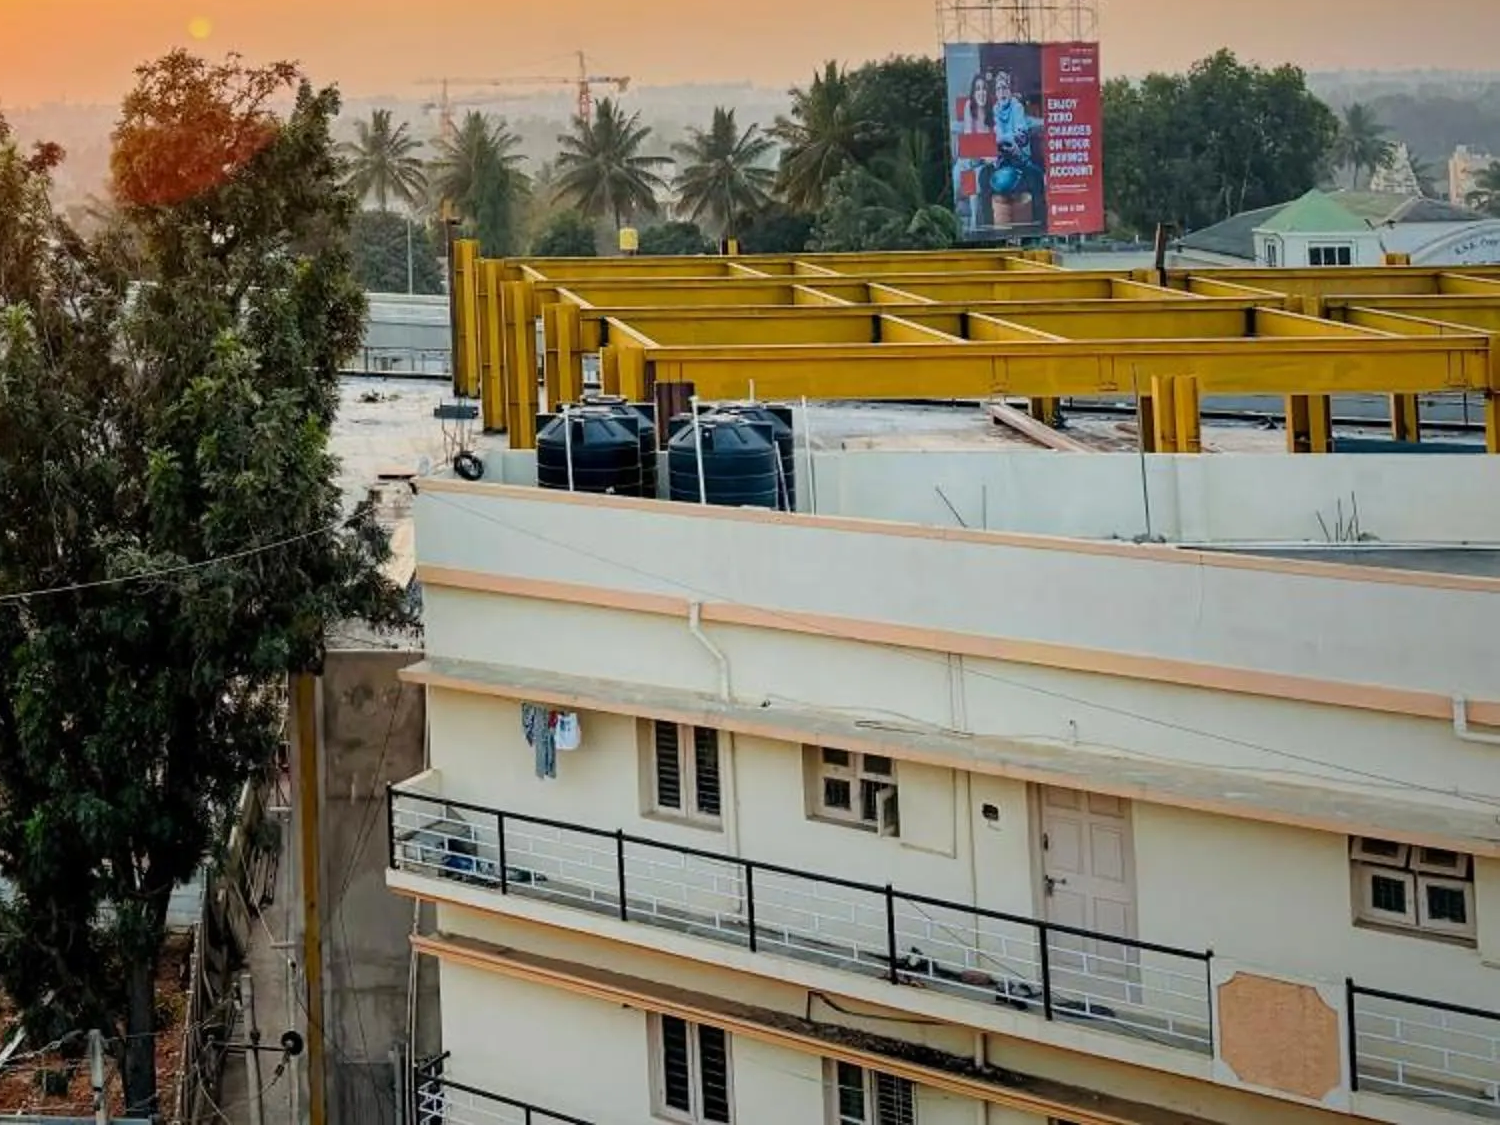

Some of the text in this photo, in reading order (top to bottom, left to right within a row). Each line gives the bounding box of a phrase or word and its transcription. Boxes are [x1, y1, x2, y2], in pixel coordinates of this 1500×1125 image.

[1047, 98, 1078, 110] ENJOY
[1048, 112, 1073, 123] ZERO
[1048, 124, 1092, 136] CHARGES
[1048, 138, 1091, 150] ON YOUR
[1049, 151, 1089, 163] SAVINGS
[1049, 164, 1093, 176] ACCOUNT
